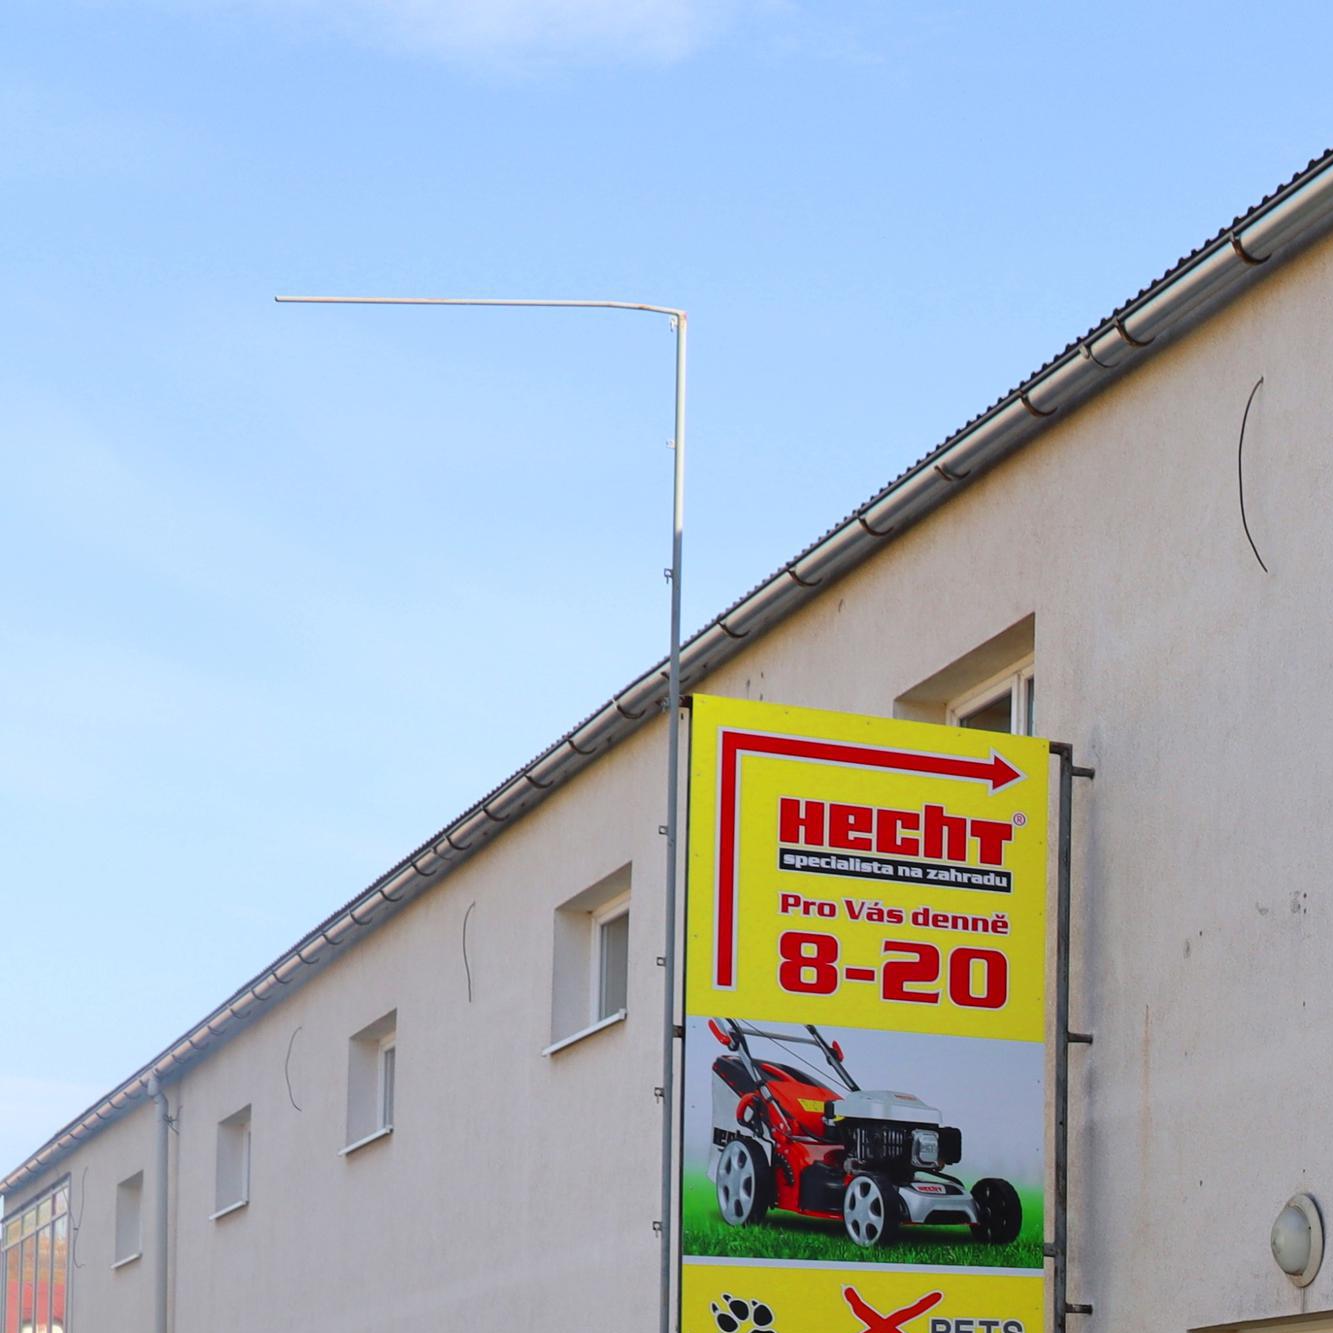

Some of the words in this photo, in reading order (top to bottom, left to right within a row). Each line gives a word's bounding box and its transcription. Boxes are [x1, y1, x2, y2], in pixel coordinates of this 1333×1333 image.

[783, 852, 895, 876] specialista
[897, 865, 925, 880] na
[926, 866, 1008, 888] zahradu
[779, 892, 837, 919] Pro
[843, 897, 904, 926] Vás
[911, 907, 1009, 935] denně
[778, 930, 1009, 1010] 8-20
